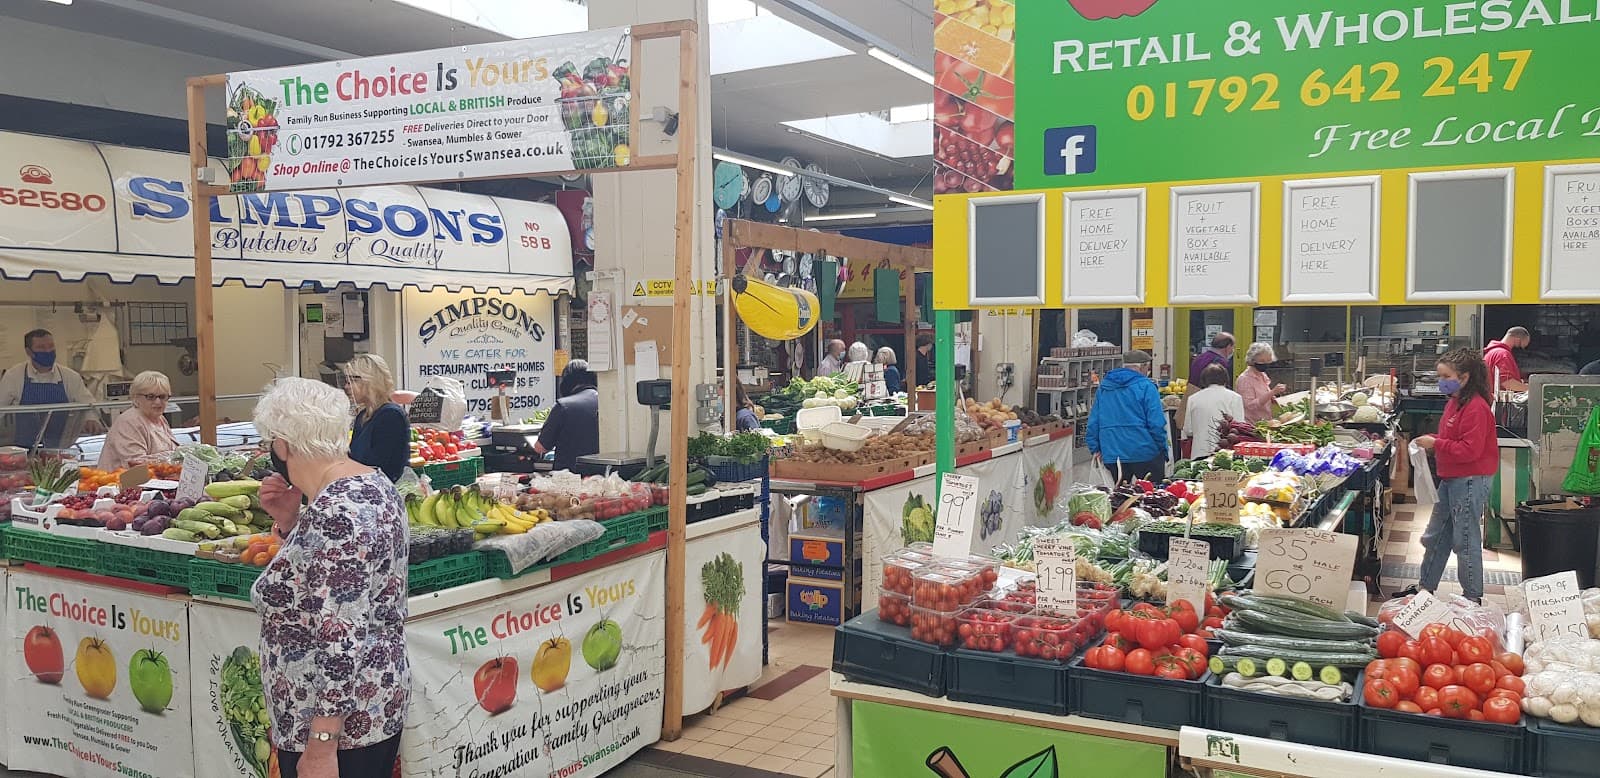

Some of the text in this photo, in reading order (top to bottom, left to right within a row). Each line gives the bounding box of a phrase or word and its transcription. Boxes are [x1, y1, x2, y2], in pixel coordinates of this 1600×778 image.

[1051, 0, 1600, 75] RETAIL & WHOLESAL
[279, 57, 549, 107] The Choice Is Yours
[1125, 49, 1533, 122] 01792 642 247
[287, 95, 542, 126] Family Run Business Supporting LOCAL & BRITISH Produce
[402, 113, 549, 134] FREE Deliveries Direct to your Door
[1308, 103, 1577, 158] Free Local
[304, 129, 395, 150] 01792 367255
[446, 132, 485, 144] Mumbles
[486, 131, 493, 140] &
[494, 129, 522, 140] Gower
[273, 163, 300, 178] Shop
[302, 160, 338, 174] Online
[1188, 200, 1224, 213] FRUIT
[1302, 195, 1340, 209] FREE
[128, 176, 504, 244] SIMPSON'S
[1080, 207, 1114, 220] FREE
[1080, 224, 1114, 235] HOME
[1186, 224, 1237, 234] VEGETABLE
[1301, 217, 1338, 229] HOME
[212, 228, 444, 265] Butchers of Quality
[521, 236, 551, 250] 58 B
[1079, 238, 1129, 252] DELIVERY
[1300, 238, 1356, 253] DELIVERY
[1563, 241, 1589, 249] HERE
[1080, 255, 1105, 267] HERE
[1184, 251, 1232, 261] AVAILABLE
[1184, 264, 1208, 273] HERE
[1301, 260, 1329, 270] HERE
[653, 281, 672, 289] CCTV
[418, 297, 546, 345] SIMPSONS
[450, 317, 489, 337] Quality
[440, 348, 527, 359] WE CATER FOR
[419, 364, 489, 376] RESTAURANTS
[517, 361, 545, 372] HOMES
[467, 395, 540, 412] 1792 52580
[1036, 550, 1070, 558] TOMATOES
[1313, 560, 1341, 570] HALF
[1309, 595, 1334, 605] EACH
[15, 586, 180, 642] The Choice Is Yours
[443, 579, 636, 655] The Choice Is Yours
[1395, 599, 1417, 620] TASTY
[1400, 596, 1433, 629] TOMATOES
[111, 710, 139, 726] Supporting
[209, 679, 219, 713] Love
[215, 716, 234, 754] What
[592, 687, 661, 735] Greengrocers
[103, 717, 134, 733] PRODUCERS
[453, 668, 649, 770] Thank you for supporting your
[115, 743, 131, 754] Gower
